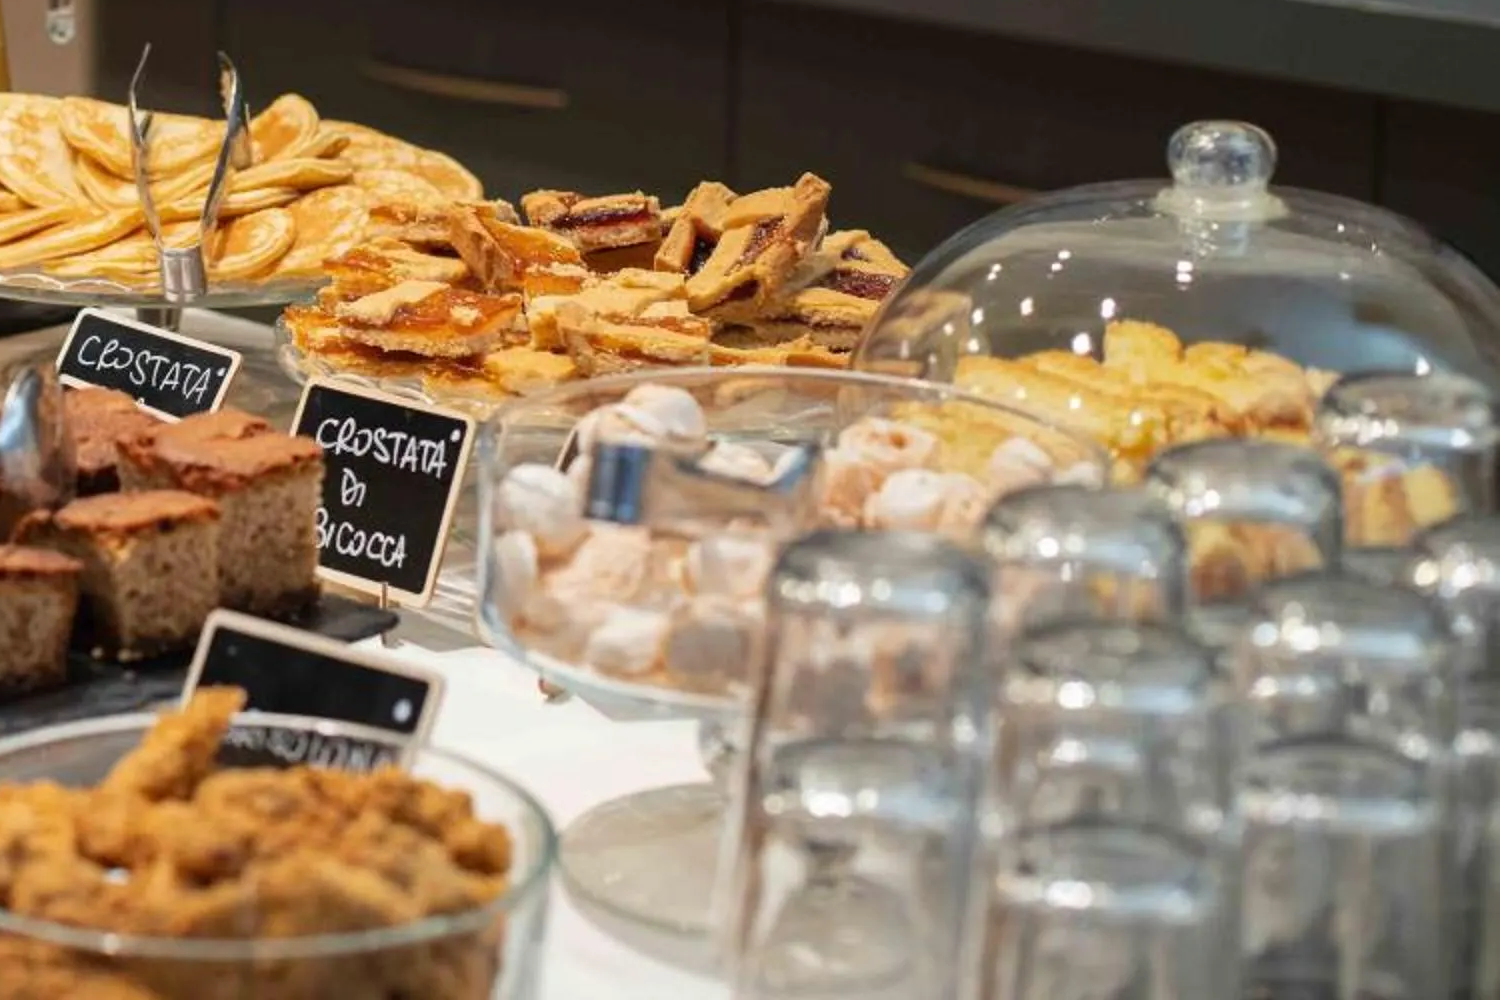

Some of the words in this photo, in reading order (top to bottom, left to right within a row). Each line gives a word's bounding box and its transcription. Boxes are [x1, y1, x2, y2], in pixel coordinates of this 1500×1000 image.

[77, 335, 212, 405] CROSTATA
[315, 417, 448, 479] CROSTATA
[341, 467, 367, 508] DI
